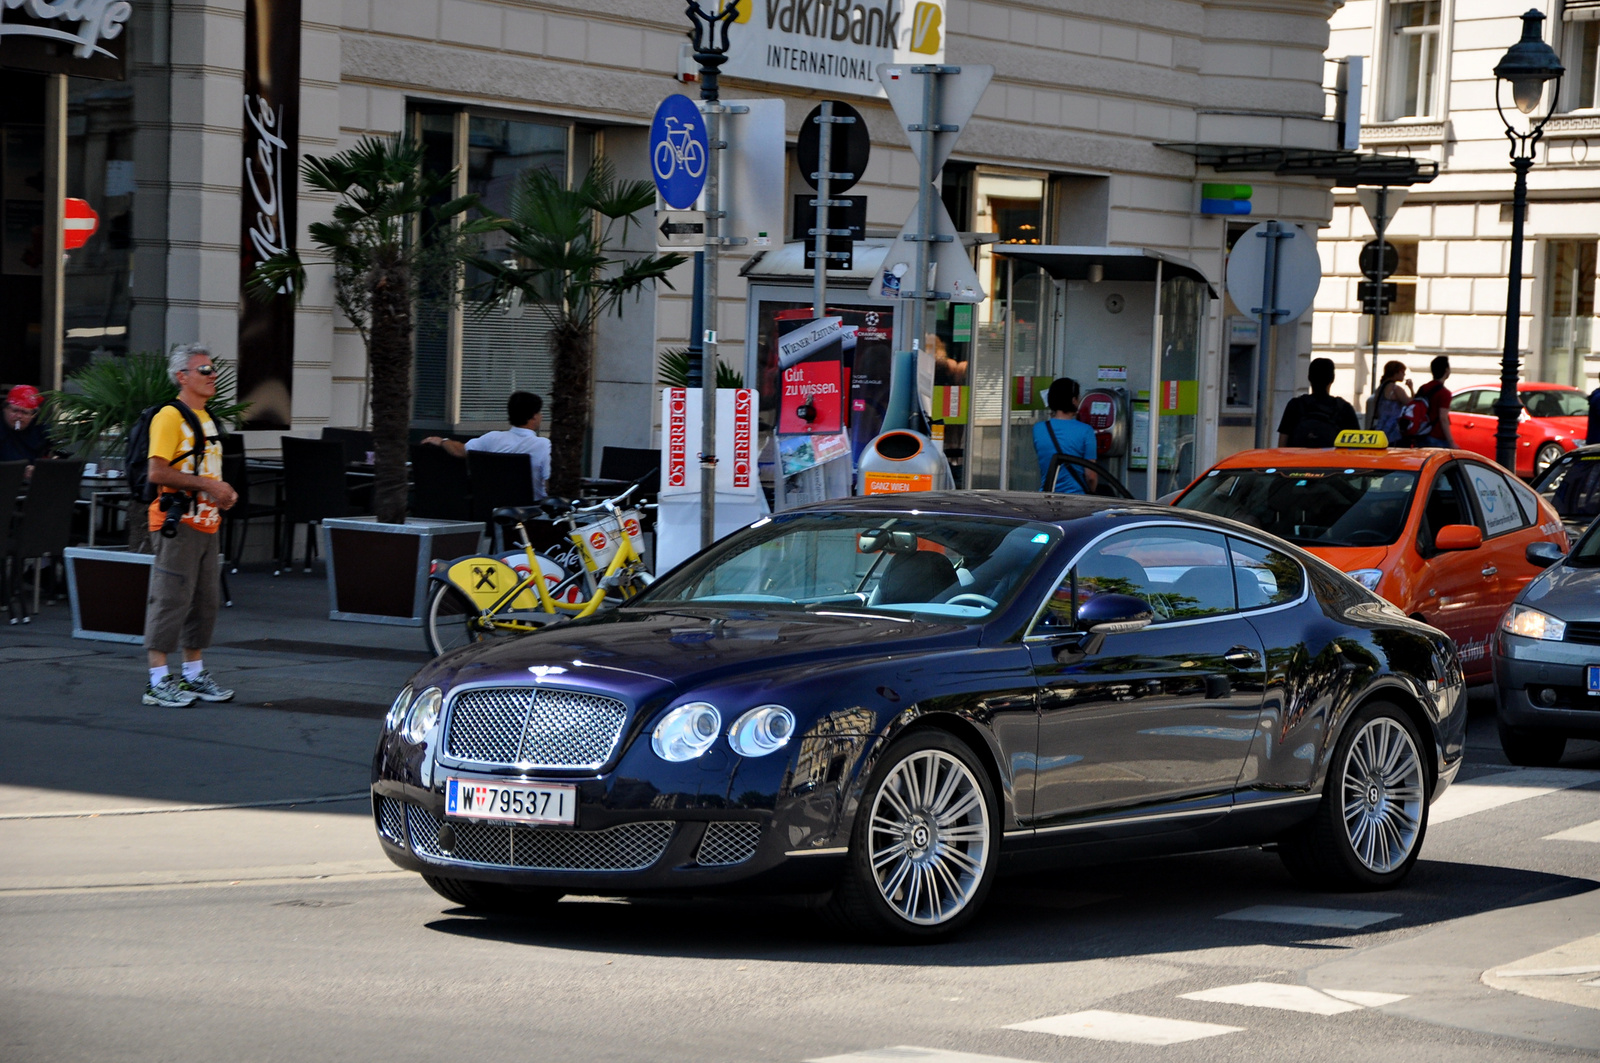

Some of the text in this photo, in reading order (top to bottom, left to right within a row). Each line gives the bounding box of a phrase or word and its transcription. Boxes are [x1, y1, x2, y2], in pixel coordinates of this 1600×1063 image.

[767, 44, 874, 82] INTERNATIONAL
[784, 368, 804, 382] Gut
[785, 381, 839, 396] zu wissen.
[669, 390, 685, 486] ÖSTERREICH
[735, 389, 752, 486] ÖSTERREICH
[1342, 433, 1377, 444] TAXI
[871, 481, 911, 492] GANZ WIEN
[463, 787, 475, 810] W
